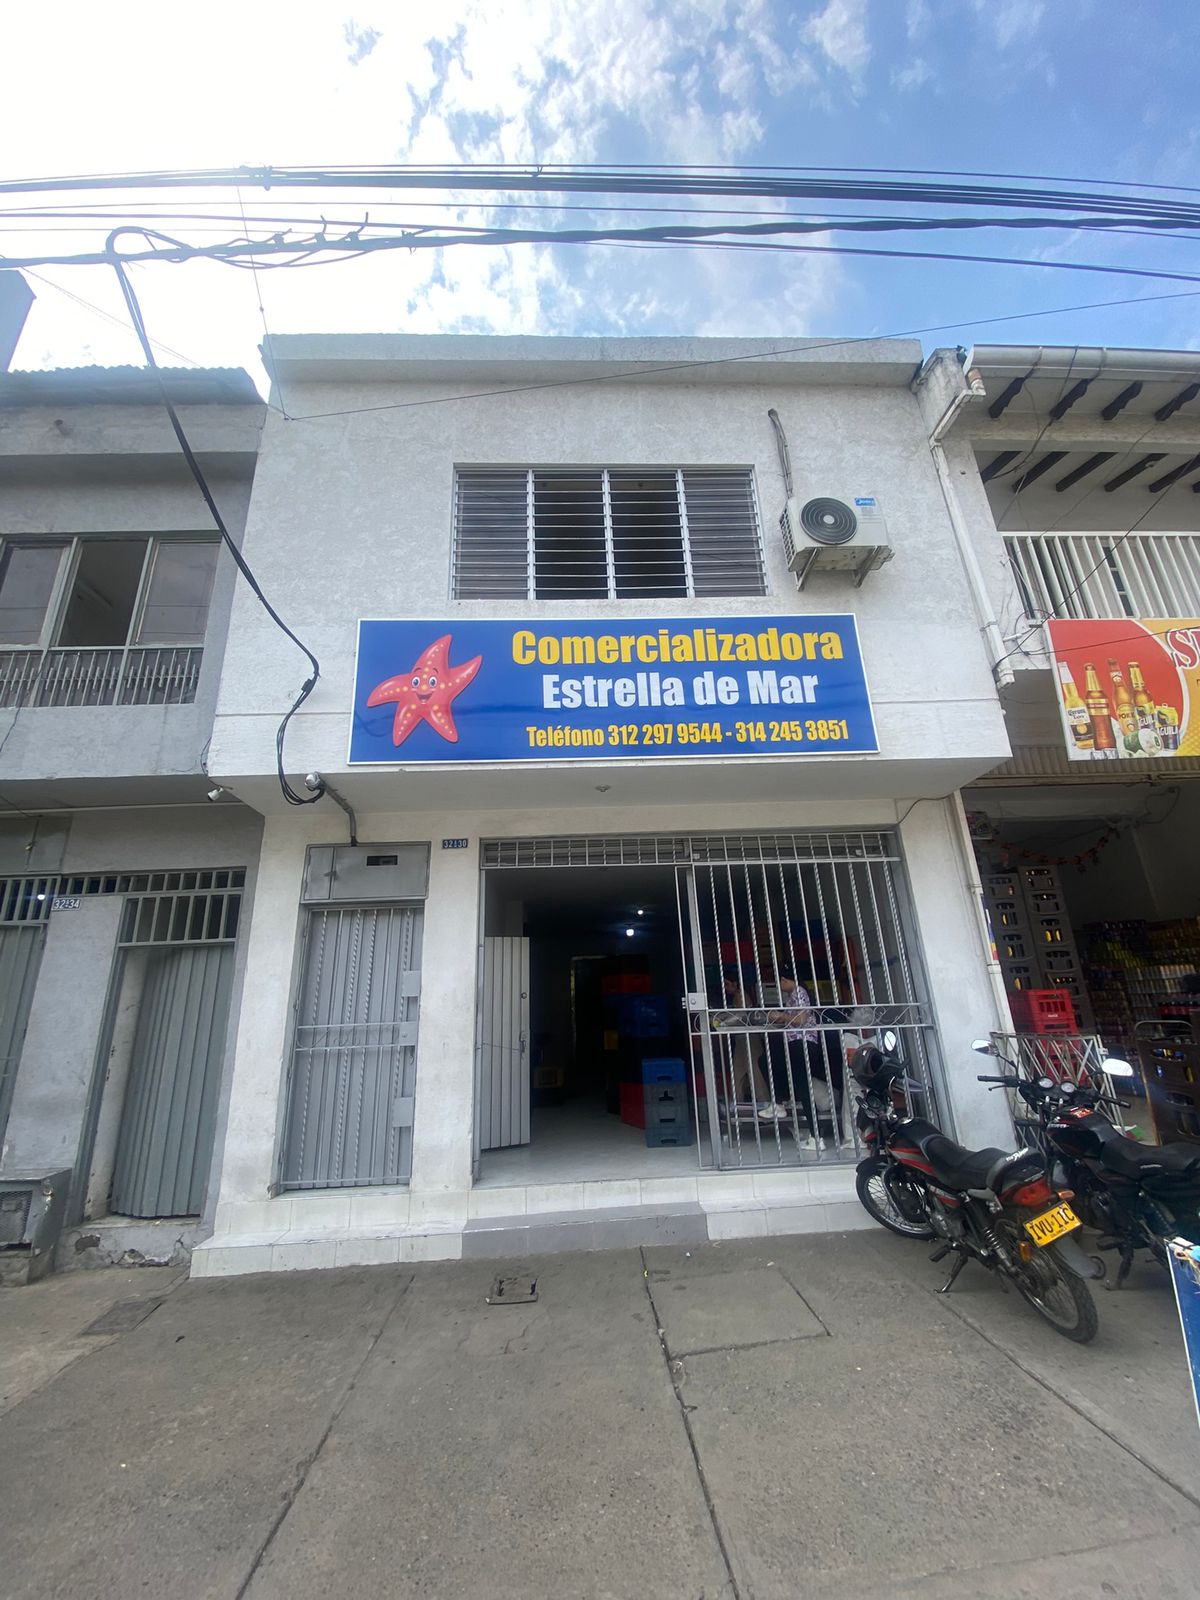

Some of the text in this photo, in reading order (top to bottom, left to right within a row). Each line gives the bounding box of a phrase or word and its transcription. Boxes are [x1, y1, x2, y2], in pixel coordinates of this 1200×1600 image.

[512, 627, 844, 665] Comercializadora
[542, 670, 819, 709] Estrella de Mar
[526, 725, 605, 747] Teléfono
[607, 724, 639, 746] 312
[642, 723, 674, 745] 297
[676, 722, 723, 744] 9544
[735, 721, 767, 743] 314
[768, 720, 803, 742] 245
[805, 719, 849, 741] 3851
